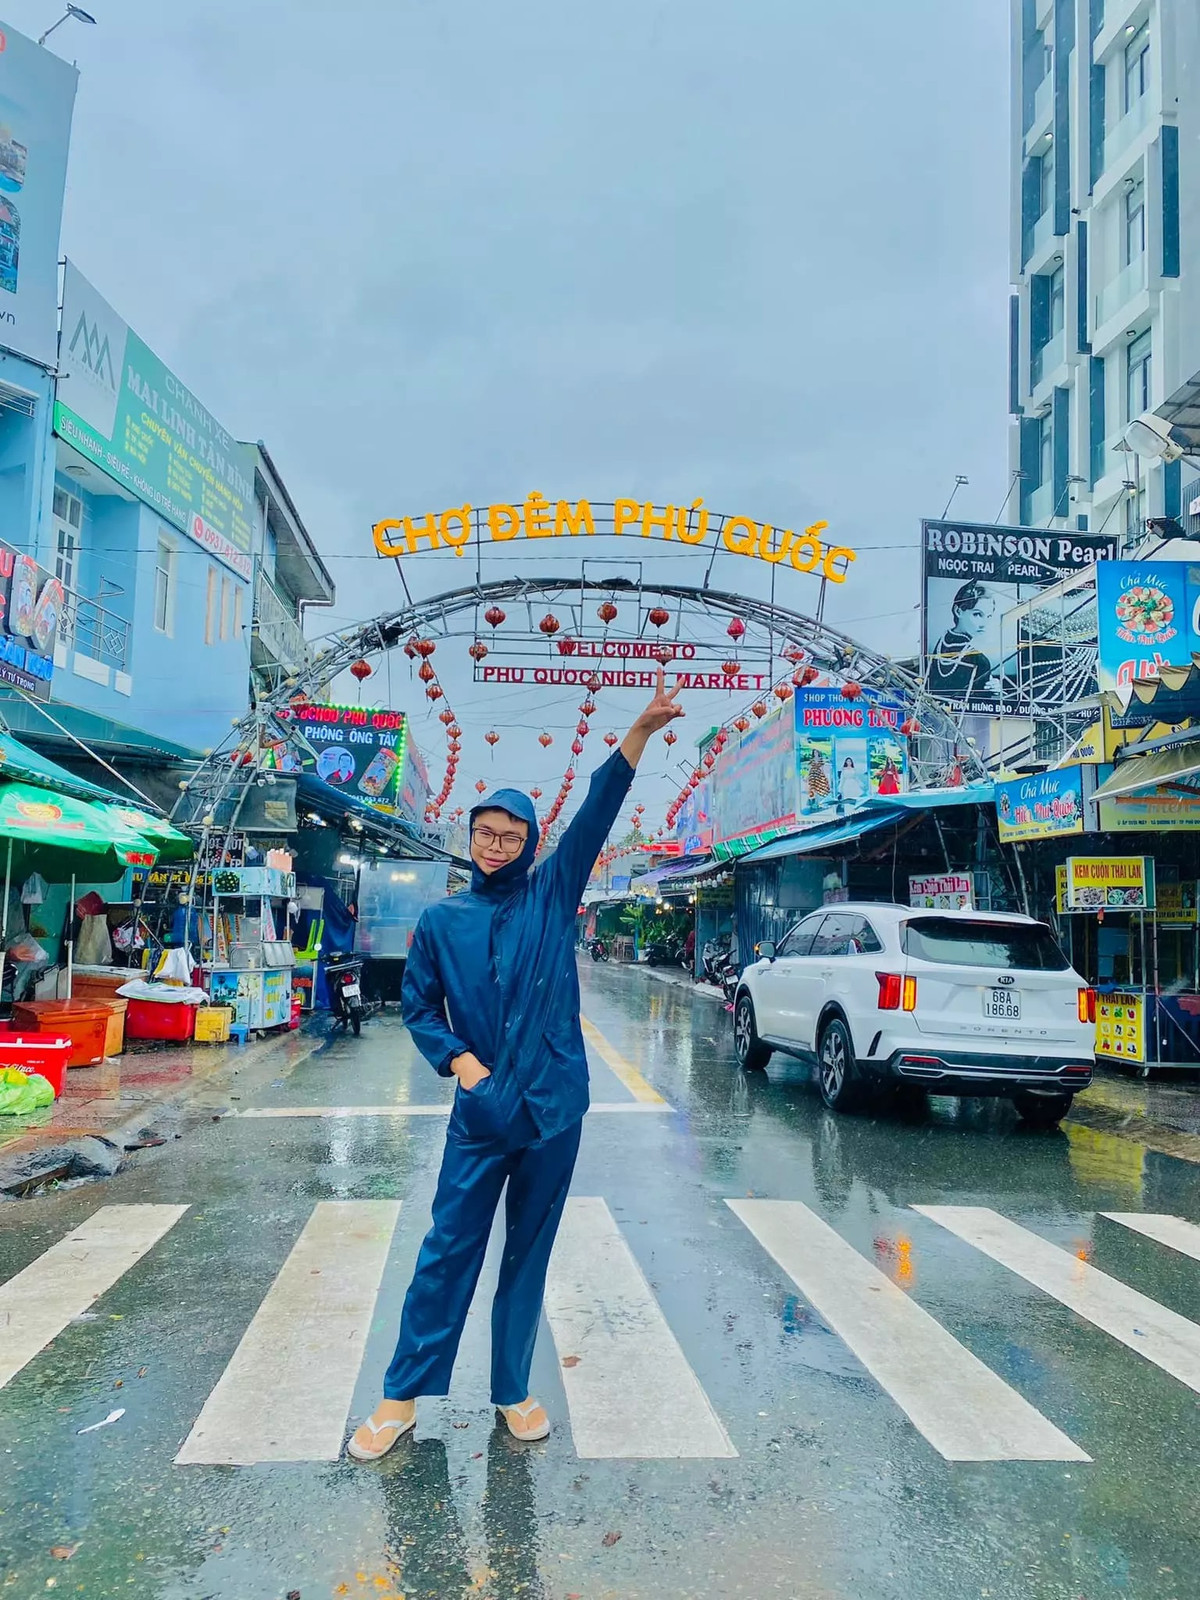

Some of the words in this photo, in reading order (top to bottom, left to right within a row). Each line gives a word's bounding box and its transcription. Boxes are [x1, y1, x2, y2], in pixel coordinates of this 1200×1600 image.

[127, 365, 159, 415] MAI
[161, 398, 196, 451] LINH
[198, 435, 225, 480] TÂN
[60, 415, 78, 439] SIÊU
[78, 427, 102, 458] NHANH
[373, 503, 472, 557] CHỢ
[487, 490, 596, 540] ĐÊM
[614, 497, 709, 544] PHÚ
[722, 516, 856, 583] QUỐC
[927, 528, 1050, 561] ROBINSON
[1057, 539, 1114, 563] Pearl
[938, 558, 969, 574] NGỌC
[970, 560, 995, 574] TRAI
[1007, 564, 1042, 577] PEARL
[556, 640, 662, 659] WELCOME
[669, 643, 696, 659] TO
[483, 666, 524, 682] PHU
[533, 668, 593, 685] QUOC
[602, 670, 667, 688] NIGH
[676, 672, 765, 690] MARKET
[803, 693, 826, 703] SHOP
[304, 724, 344, 742] PHỘNG
[349, 728, 373, 744] ÔNG
[378, 731, 399, 747] TÂY
[1074, 864, 1089, 878] KEM
[1090, 861, 1110, 881] CUỘN
[1128, 864, 1142, 879] LAN
[992, 991, 1012, 1004] 68A
[986, 1003, 1019, 1017] 186.68
